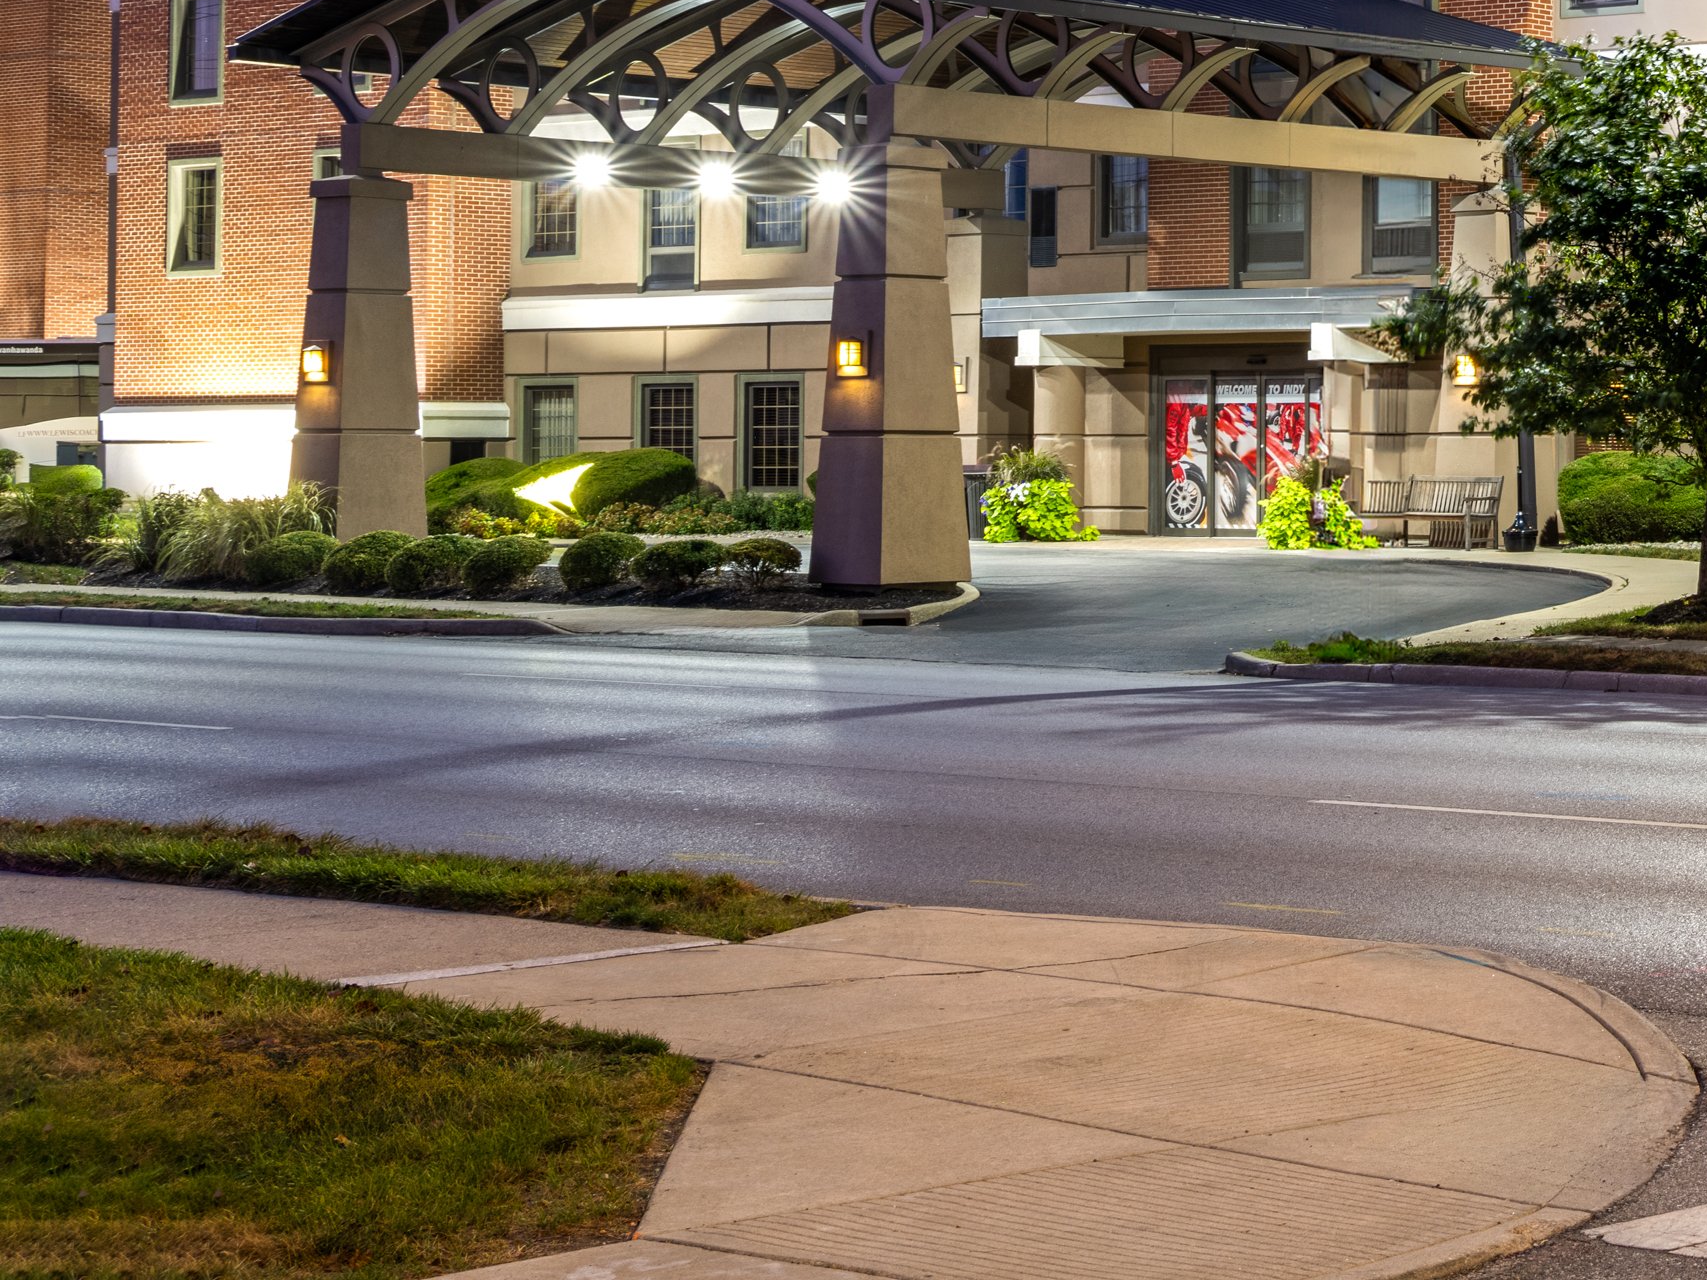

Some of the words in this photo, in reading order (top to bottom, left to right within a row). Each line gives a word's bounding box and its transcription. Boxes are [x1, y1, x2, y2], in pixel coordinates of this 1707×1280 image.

[1215, 384, 1258, 395] WELCOME
[1268, 384, 1281, 395] TO
[1282, 384, 1306, 395] INDY
